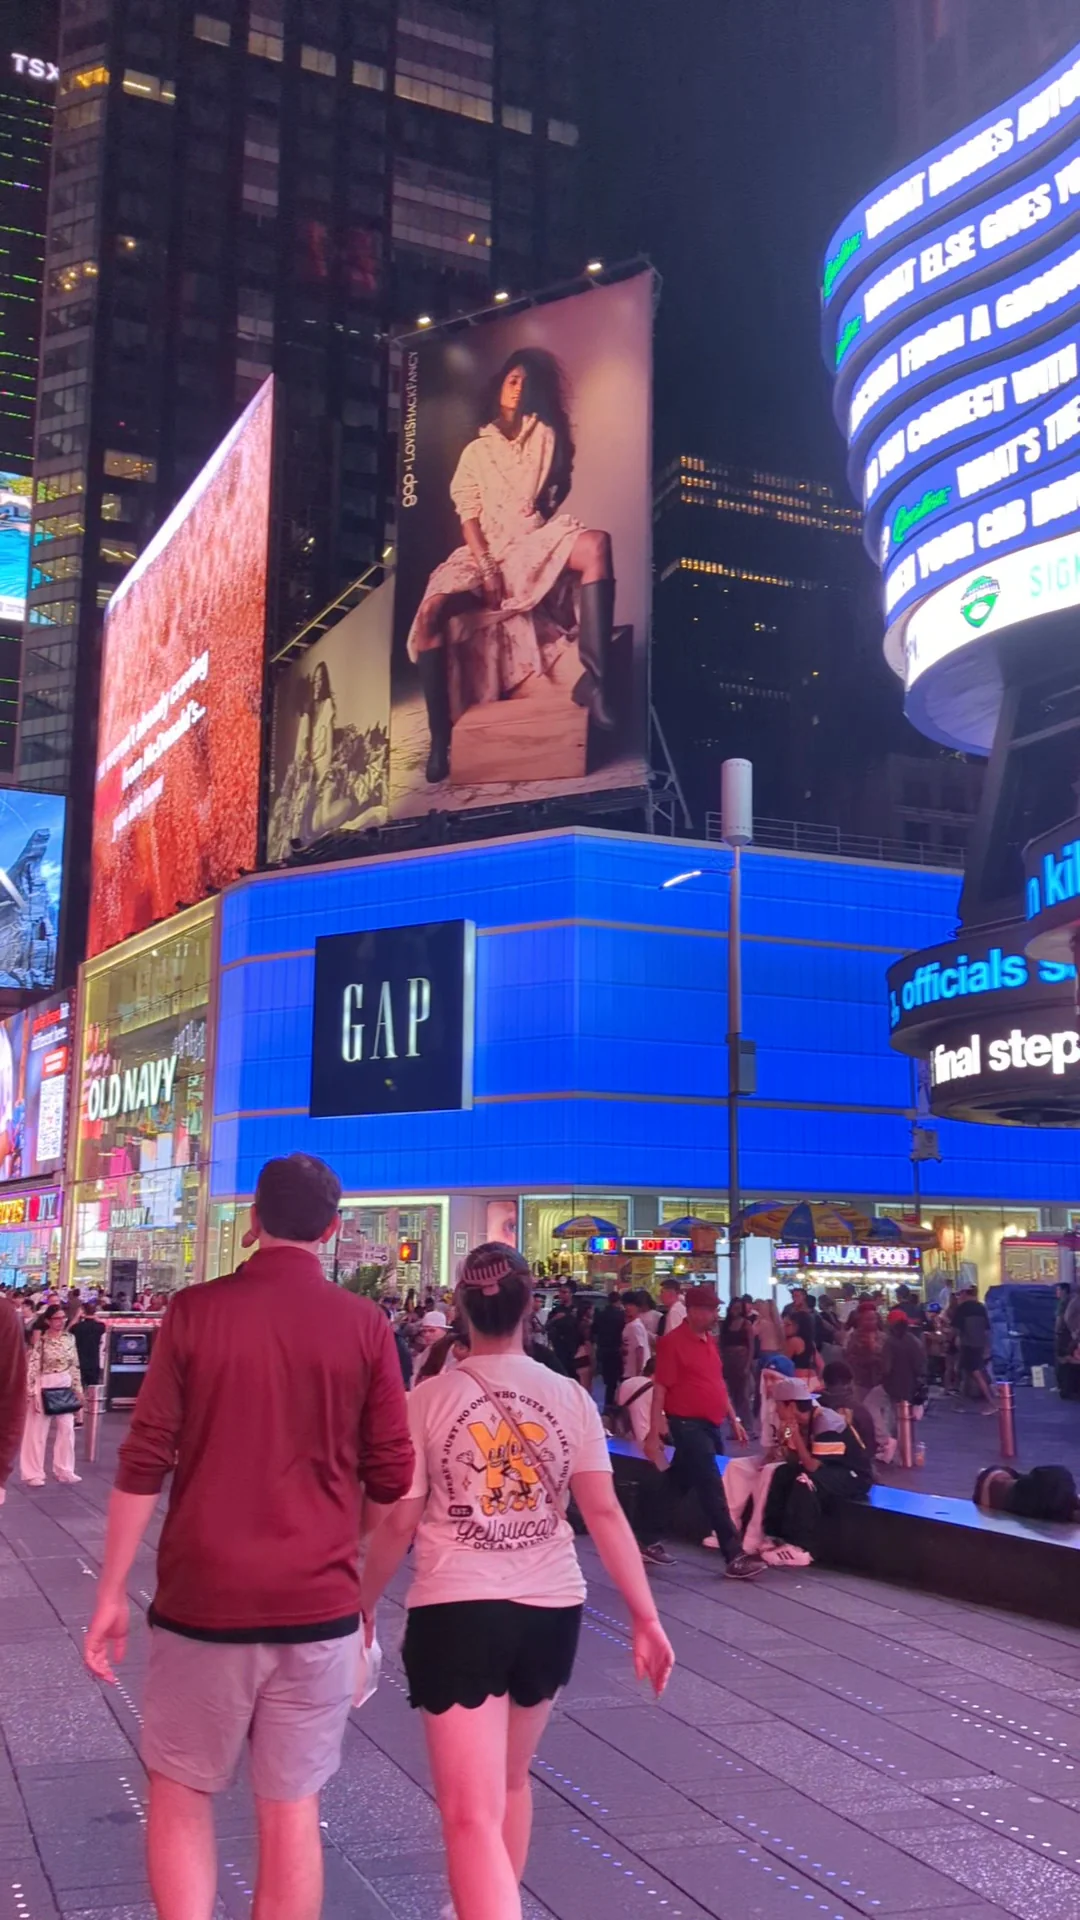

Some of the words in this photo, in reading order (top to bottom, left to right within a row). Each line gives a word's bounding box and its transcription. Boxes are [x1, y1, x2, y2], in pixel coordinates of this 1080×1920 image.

[920, 225, 976, 283] ELSE
[404, 351, 418, 463] LOVESHACKFANCY
[402, 473, 418, 508] gap
[902, 949, 1029, 1010] officials
[341, 977, 431, 1063] GAP
[934, 1034, 981, 1084] final
[989, 1029, 1080, 1076] step
[88, 1073, 121, 1121] OLD
[122, 1055, 177, 1113] NAVY
[637, 1239, 662, 1251] HOT
[816, 1245, 867, 1265] HALAL
[868, 1246, 909, 1265] FOOD
[442, 1425, 459, 1455] JUST
[457, 1409, 470, 1425] NO
[493, 1390, 517, 1400] WHO
[519, 1395, 545, 1413] GETS
[545, 1411, 559, 1428] ME
[556, 1429, 569, 1457] LIKE
[473, 1541, 513, 1550] OCEAN
